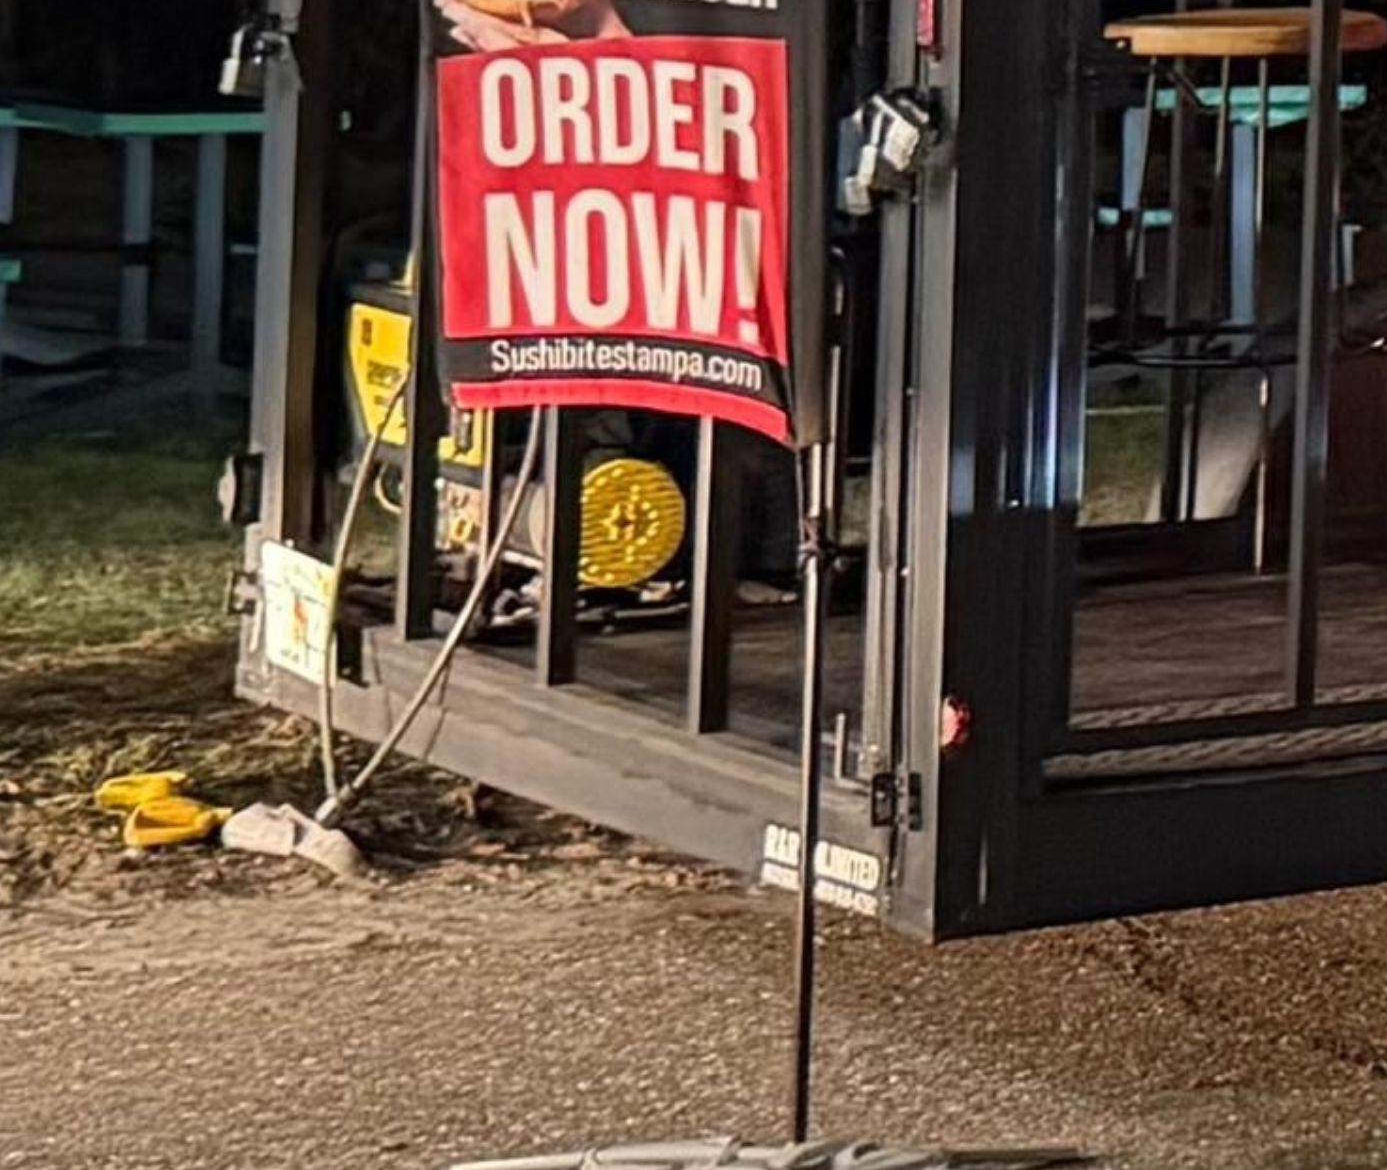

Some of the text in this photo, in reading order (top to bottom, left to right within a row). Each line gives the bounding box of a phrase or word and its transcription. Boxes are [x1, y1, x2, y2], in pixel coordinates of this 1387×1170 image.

[481, 56, 759, 182] ORDER
[484, 188, 763, 345] NOW!
[492, 338, 763, 391] Sushibitestampa.com
